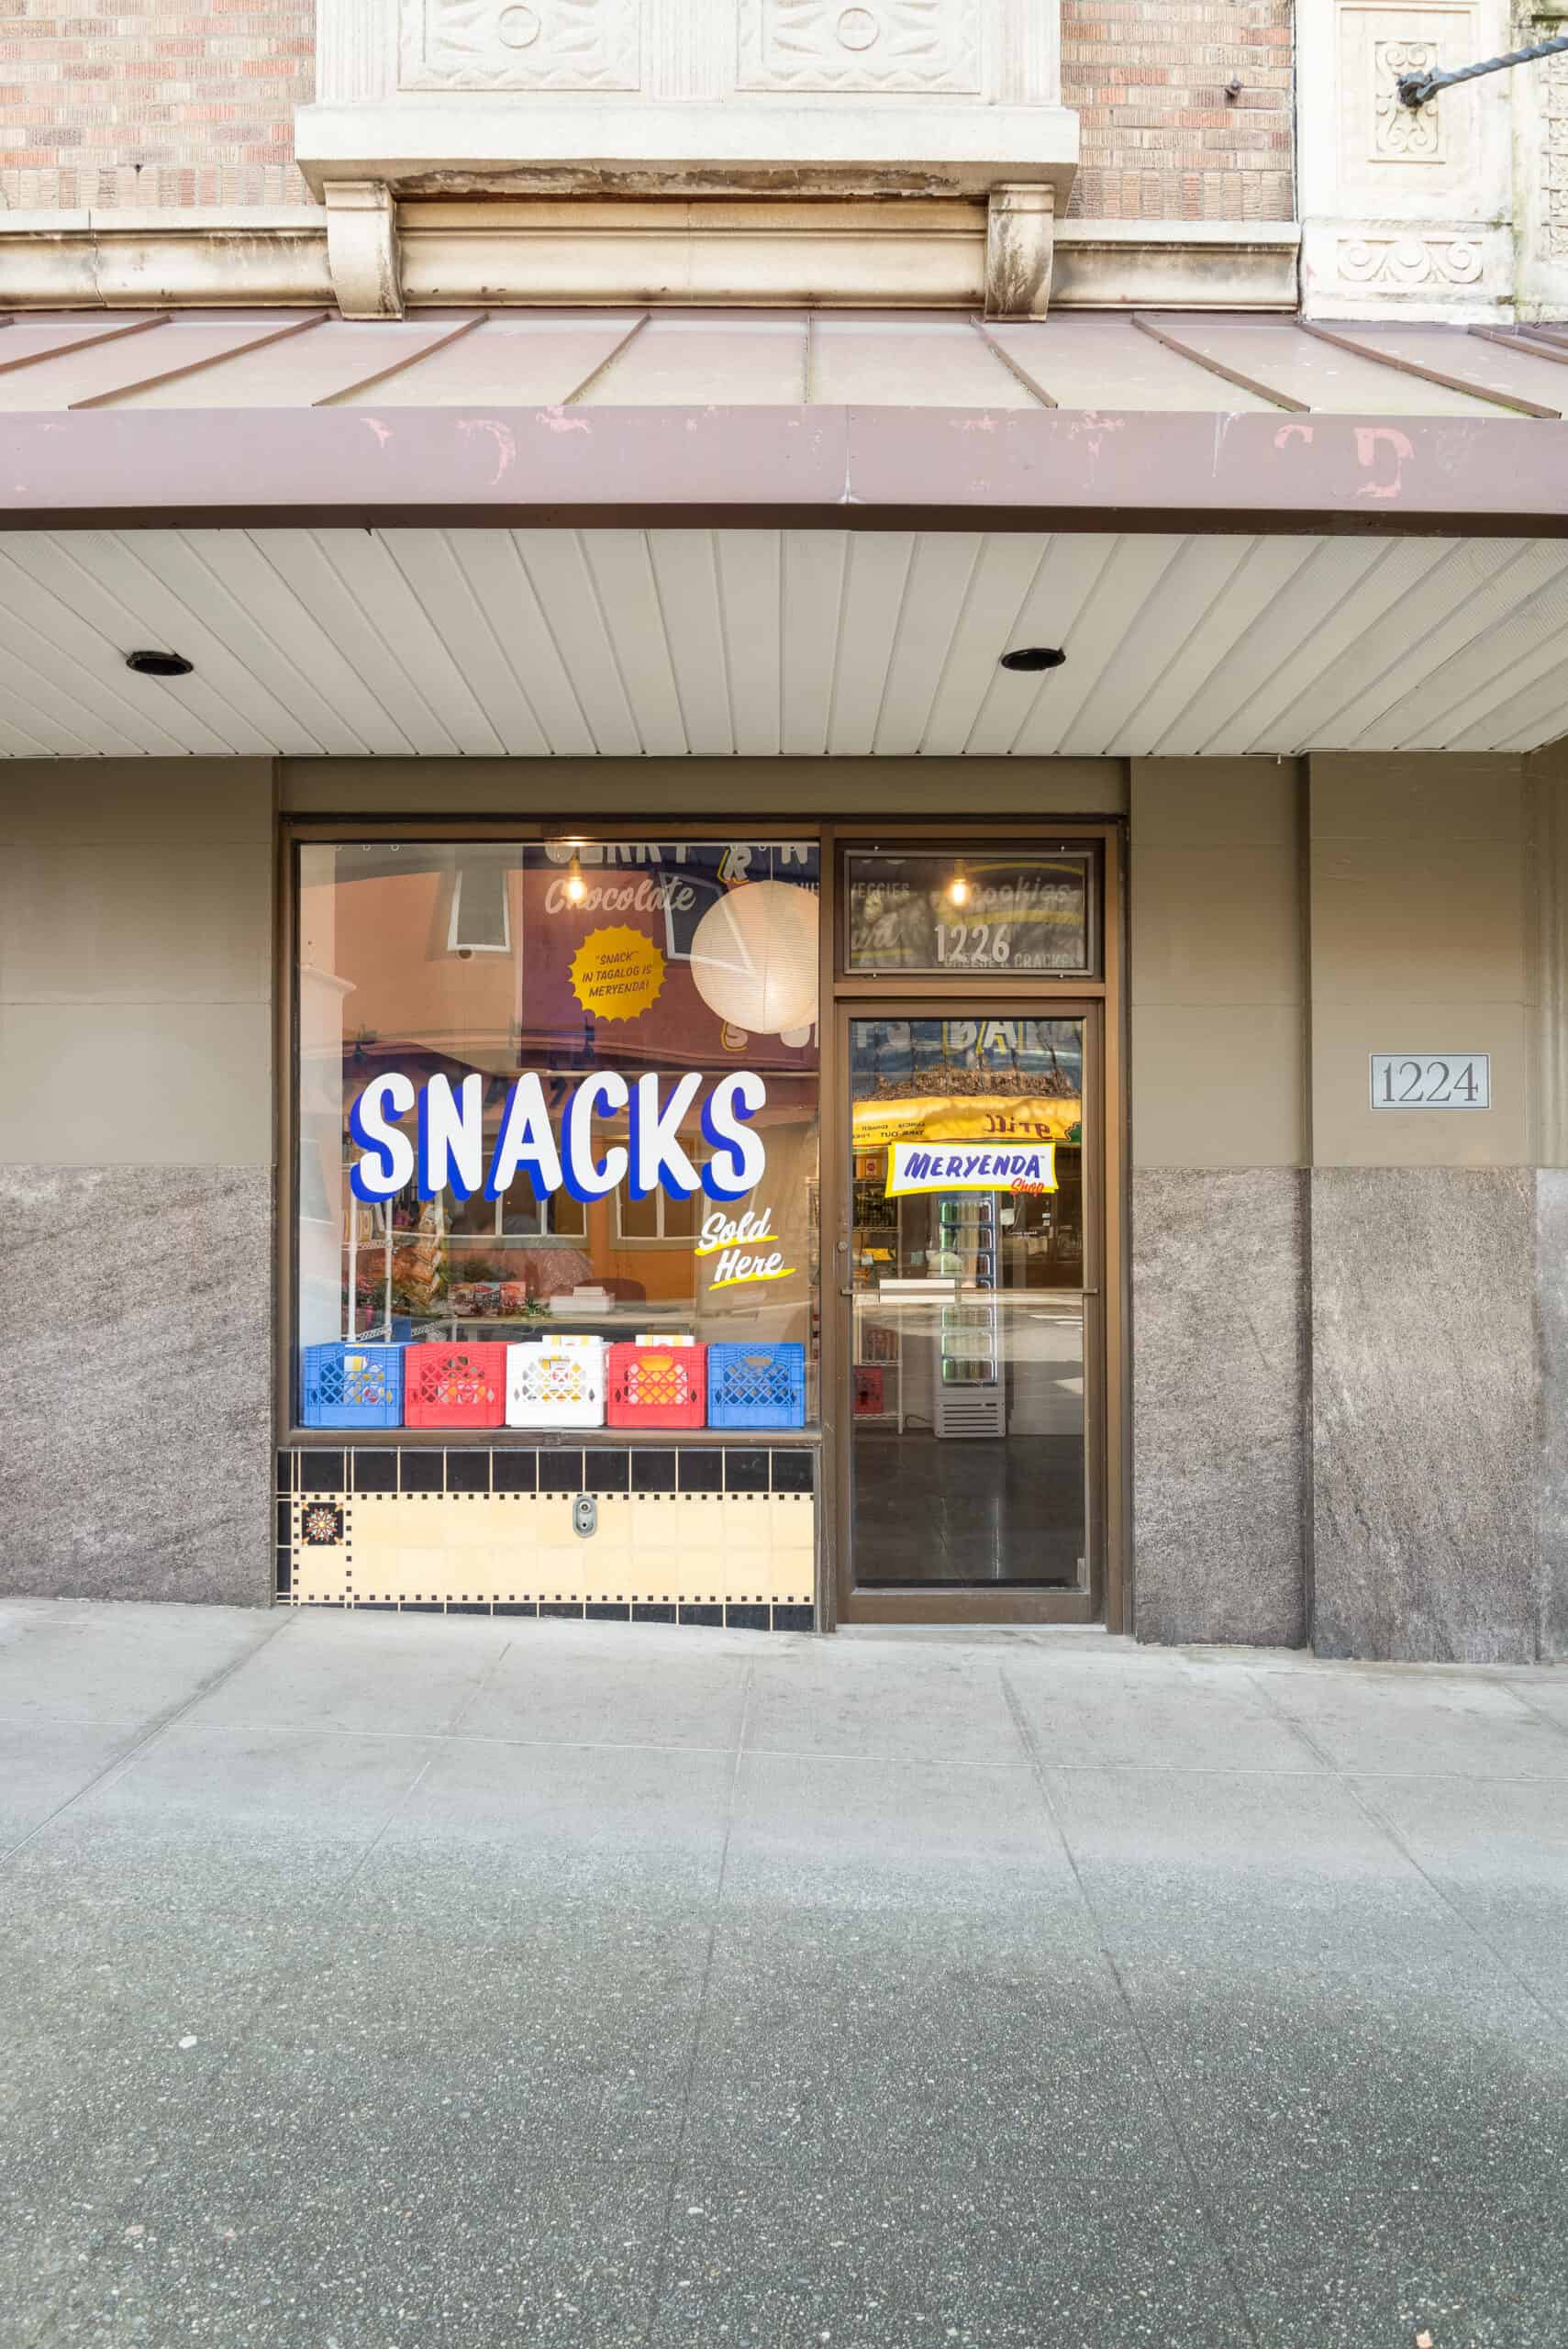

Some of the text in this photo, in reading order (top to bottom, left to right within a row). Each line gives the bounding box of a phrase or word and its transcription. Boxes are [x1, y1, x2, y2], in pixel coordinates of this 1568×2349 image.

[544, 875, 696, 915] Cocolate
[934, 923, 1010, 963] 1226
[583, 963, 653, 984] IN TAGALOG IS
[1383, 1062, 1479, 1102] 1224
[351, 1071, 767, 1203] SNACKS
[904, 1152, 1041, 1180] MERYENDA
[1008, 1177, 1045, 1197] Shop
[697, 1207, 773, 1250] Sold
[713, 1248, 785, 1283] Here
